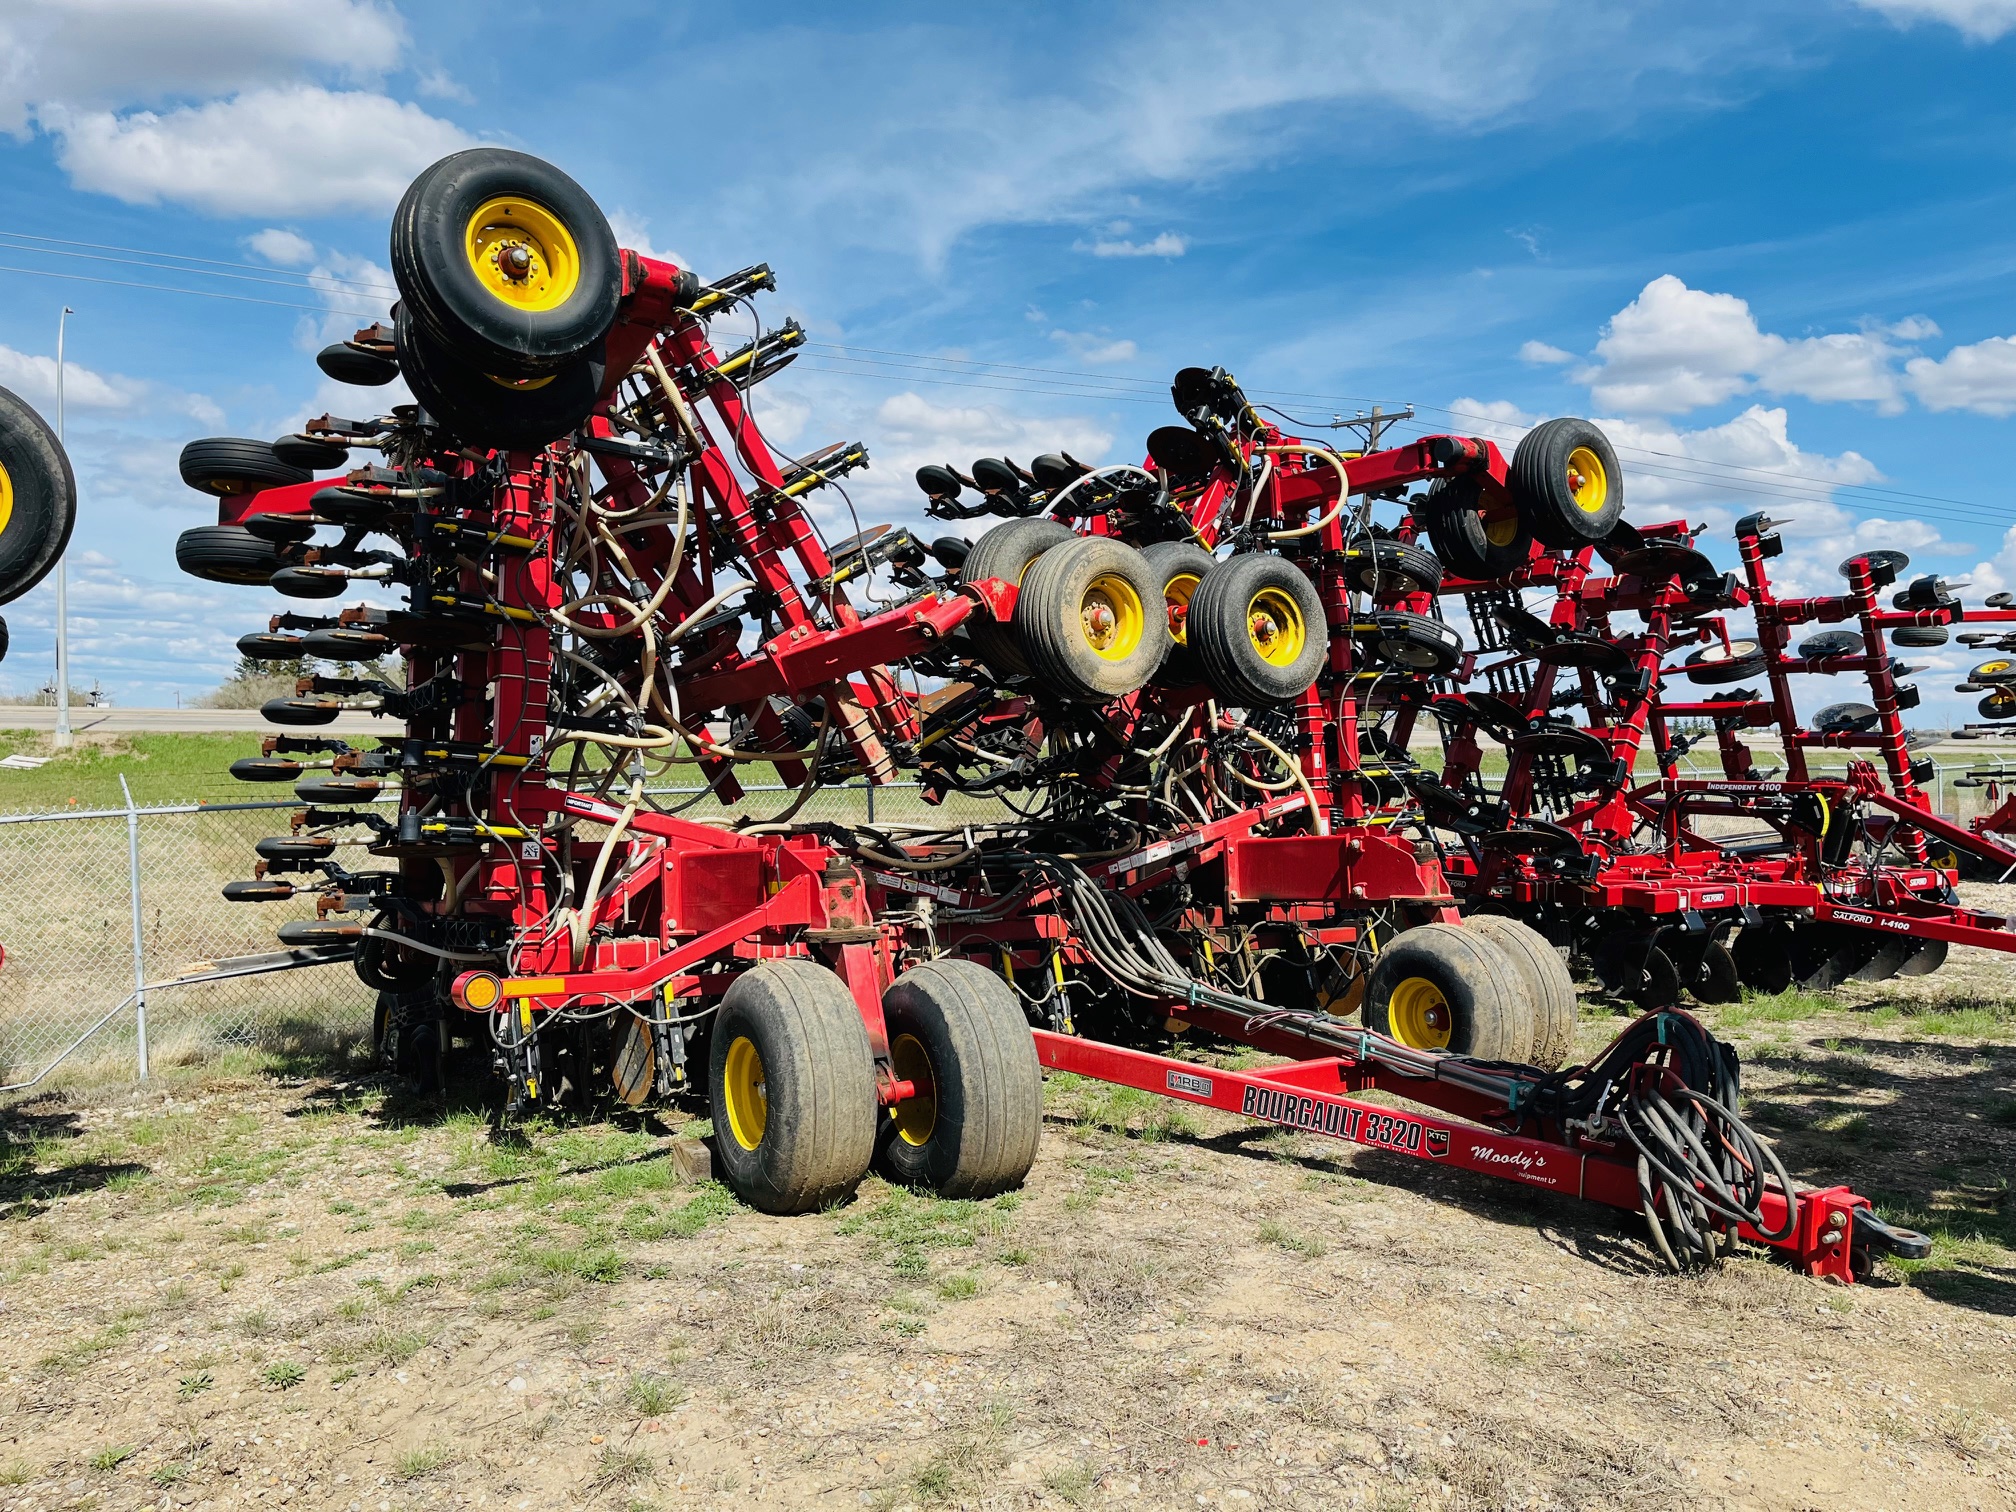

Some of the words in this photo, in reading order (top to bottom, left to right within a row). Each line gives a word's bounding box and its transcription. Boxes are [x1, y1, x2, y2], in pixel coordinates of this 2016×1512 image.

[1707, 782, 1757, 791] INDEPENDENT
[1758, 783, 1782, 792] 4100
[1832, 910, 1874, 924] SALFORD
[1880, 918, 1910, 931] I-4100
[1241, 1084, 1363, 1140] BOURGAULT
[1365, 1112, 1422, 1151] 3320
[1428, 1131, 1447, 1142] XTC
[1470, 1145, 1547, 1170] Moody's
[1516, 1170, 1547, 1183] uipment
[1548, 1177, 1557, 1185] LP
